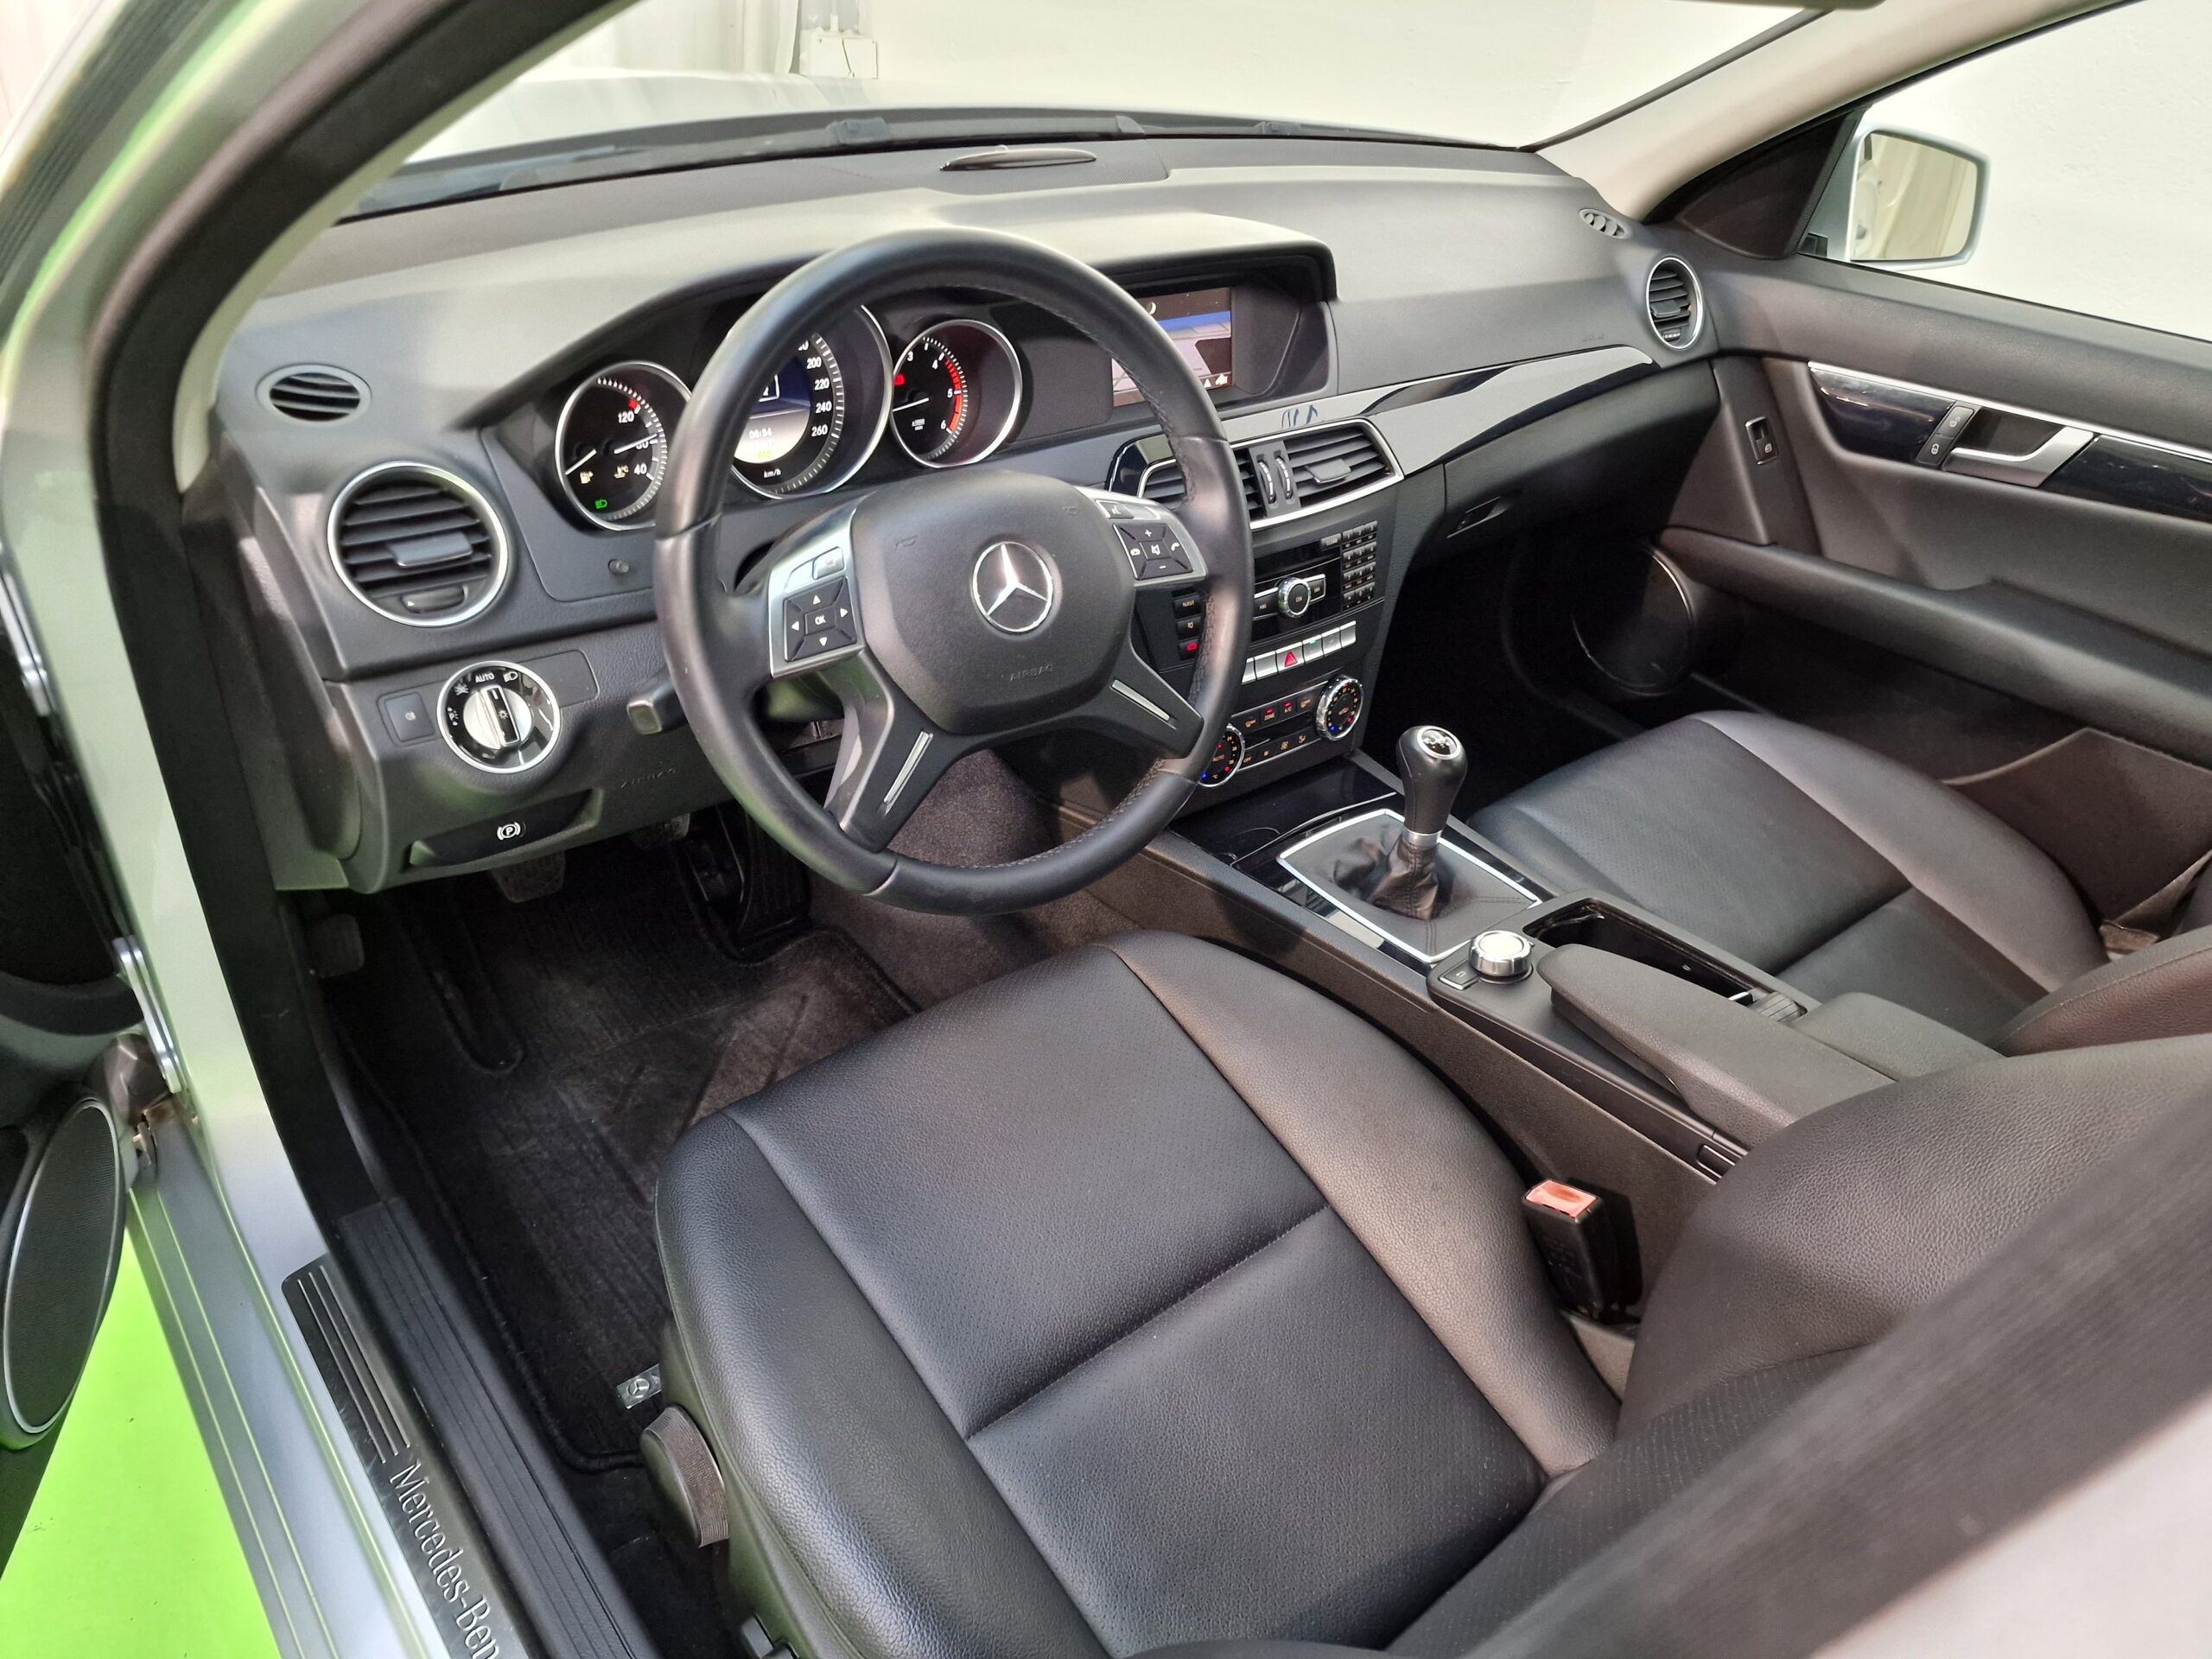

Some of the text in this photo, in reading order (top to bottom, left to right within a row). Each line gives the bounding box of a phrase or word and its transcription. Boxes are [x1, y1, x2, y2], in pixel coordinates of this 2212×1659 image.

[907, 351, 913, 362] 3
[806, 356, 822, 370] 200
[814, 378, 830, 391] 220
[947, 388, 953, 398] 5
[815, 401, 832, 414] 240
[618, 411, 635, 423] 120
[811, 424, 829, 436] 260
[940, 420, 947, 429] 6
[633, 462, 647, 475] 40
[763, 467, 781, 479] km/h
[814, 614, 827, 626] OK
[474, 671, 495, 683] AUTO
